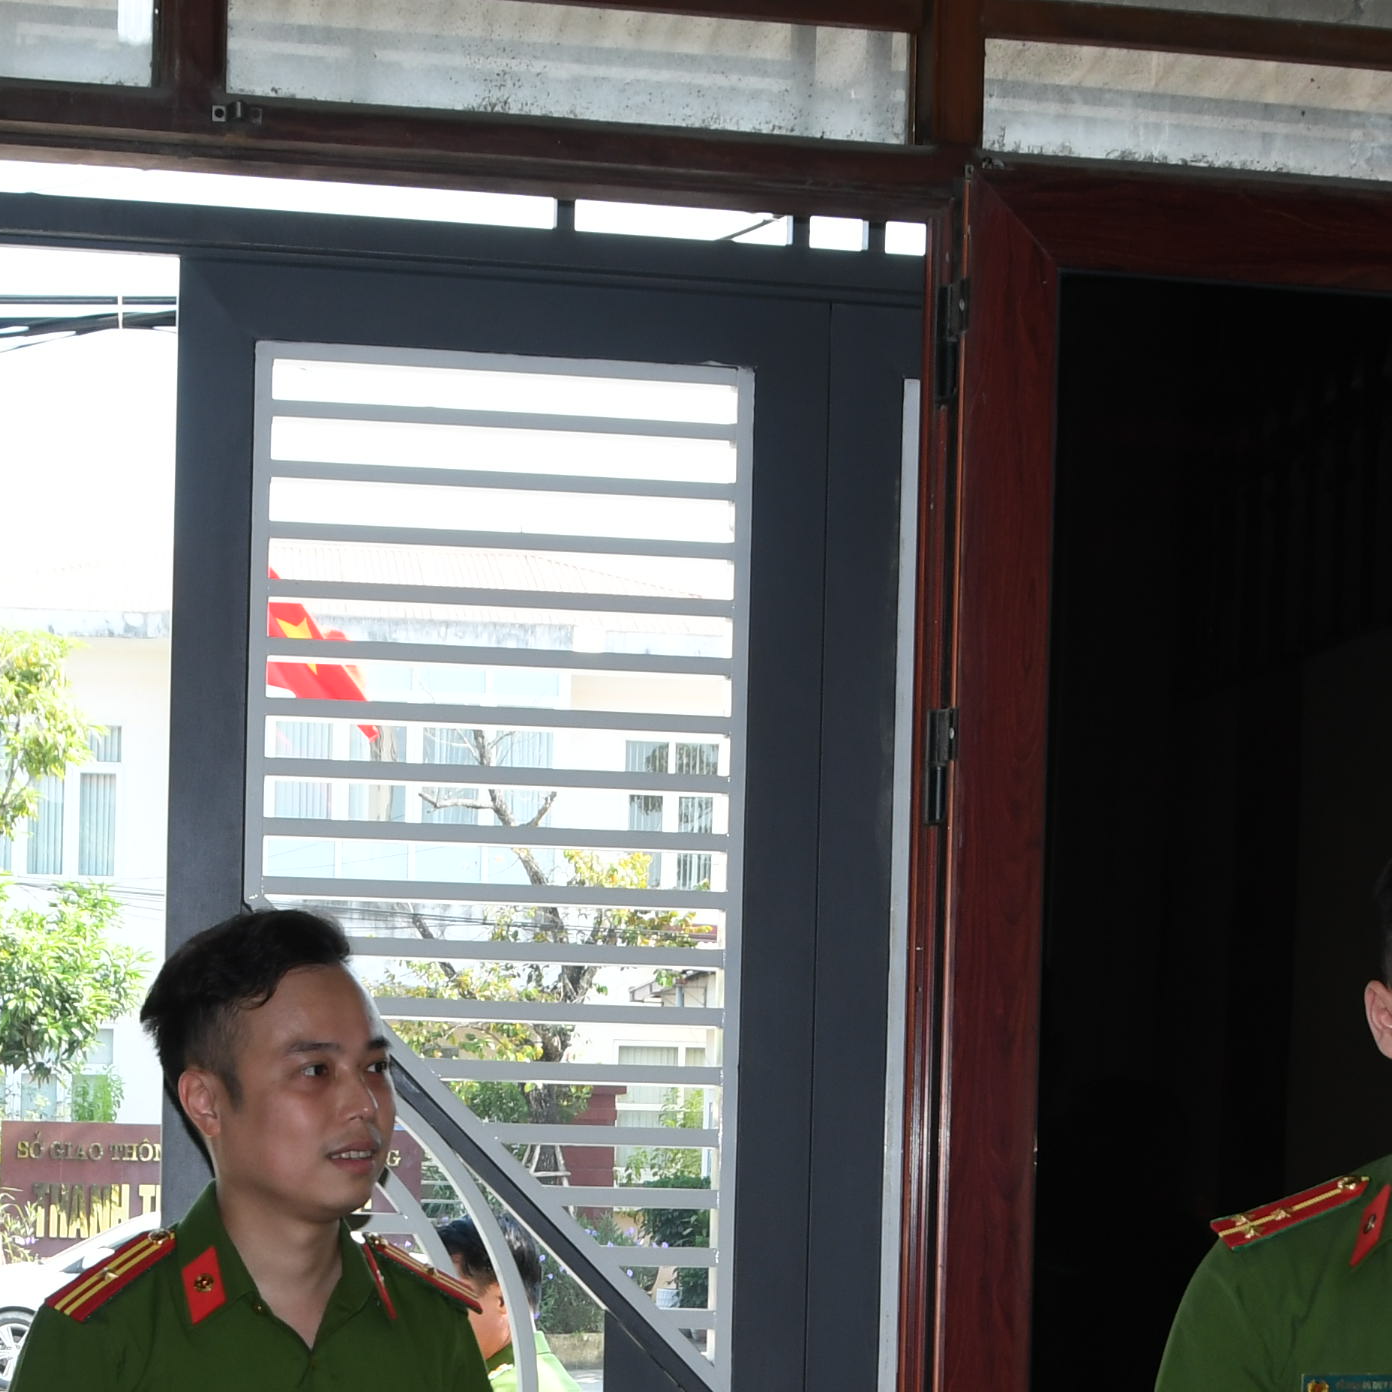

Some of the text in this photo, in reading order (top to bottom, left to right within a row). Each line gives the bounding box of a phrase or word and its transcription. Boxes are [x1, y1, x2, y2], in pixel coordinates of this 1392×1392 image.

[16, 1130, 45, 1159] SỞ
[49, 1140, 104, 1161] GIAO
[32, 1183, 130, 1239] THANH
